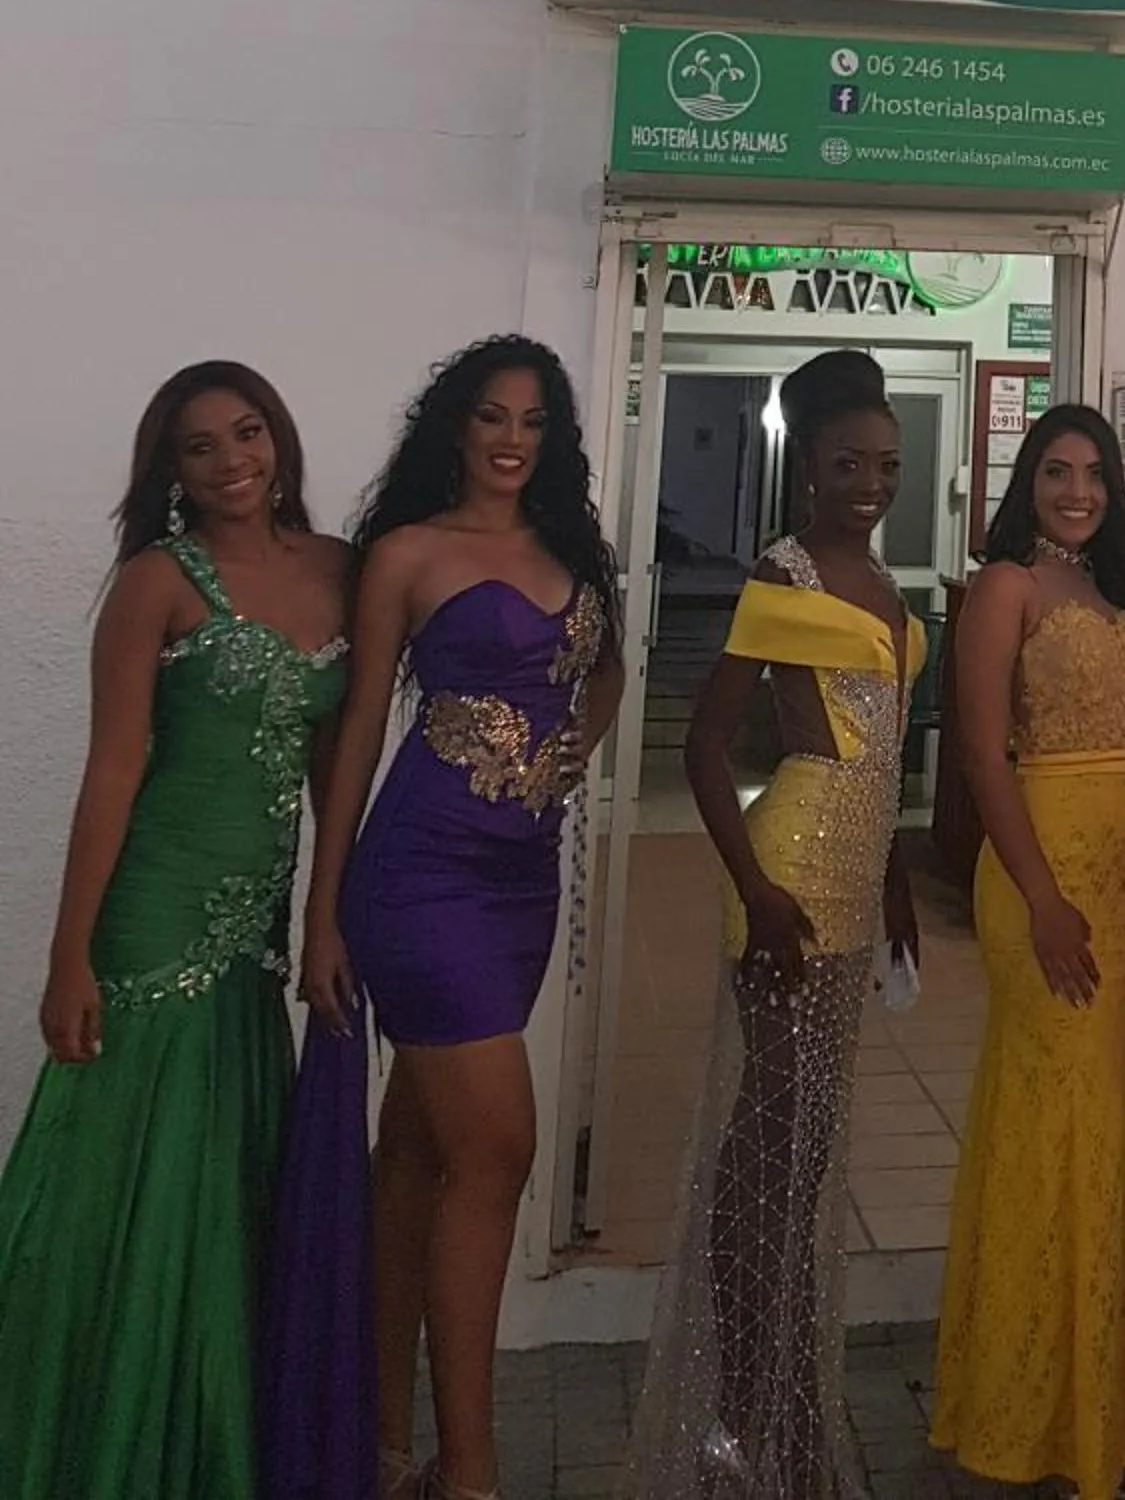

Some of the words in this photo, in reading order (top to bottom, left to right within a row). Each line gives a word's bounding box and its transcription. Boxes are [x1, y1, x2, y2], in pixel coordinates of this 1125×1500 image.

[866, 55, 896, 76] 06
[901, 56, 944, 79] 246
[952, 60, 1006, 82] 1454
[701, 128, 731, 151] LAS
[732, 129, 789, 153] PALMAS
[856, 144, 1111, 172] www.hosterialaspalmas.com.ec
